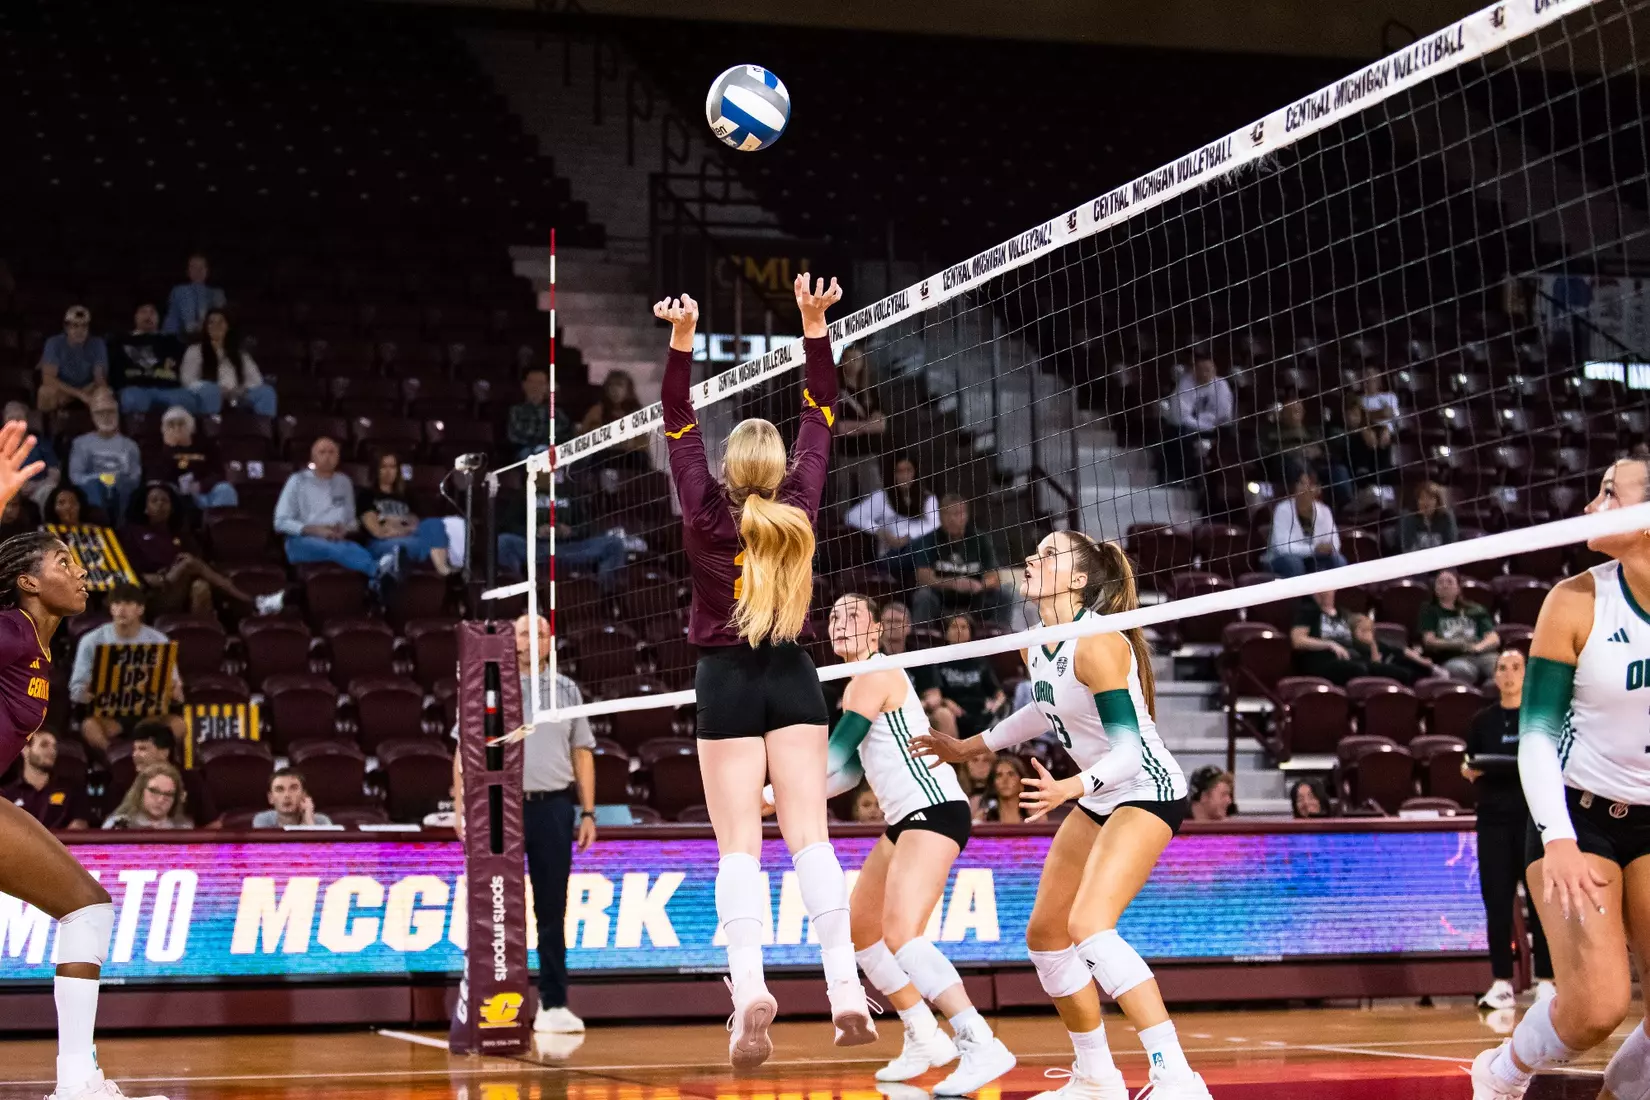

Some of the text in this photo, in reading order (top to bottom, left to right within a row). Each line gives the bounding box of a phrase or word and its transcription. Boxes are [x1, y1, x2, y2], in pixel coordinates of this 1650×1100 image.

[1285, 24, 1465, 132] CENTRAL MICHIGAN VOLLEYBALL
[1093, 136, 1233, 222] CENTRAL MICHIGAN VOLLEYBALL
[942, 222, 1052, 292] CENTRAL MICHIGAN VOLLEYBALL
[844, 307, 873, 337] MICHIGAN
[872, 290, 910, 324] VOLLEYBALL
[738, 358, 761, 383] MICHIGAN
[762, 344, 793, 374] VOLLEYBALL
[1034, 681, 1056, 707] OHIO
[111, 869, 199, 963] TO
[229, 872, 686, 953] MCGRK
[490, 875, 509, 982] sports imports
